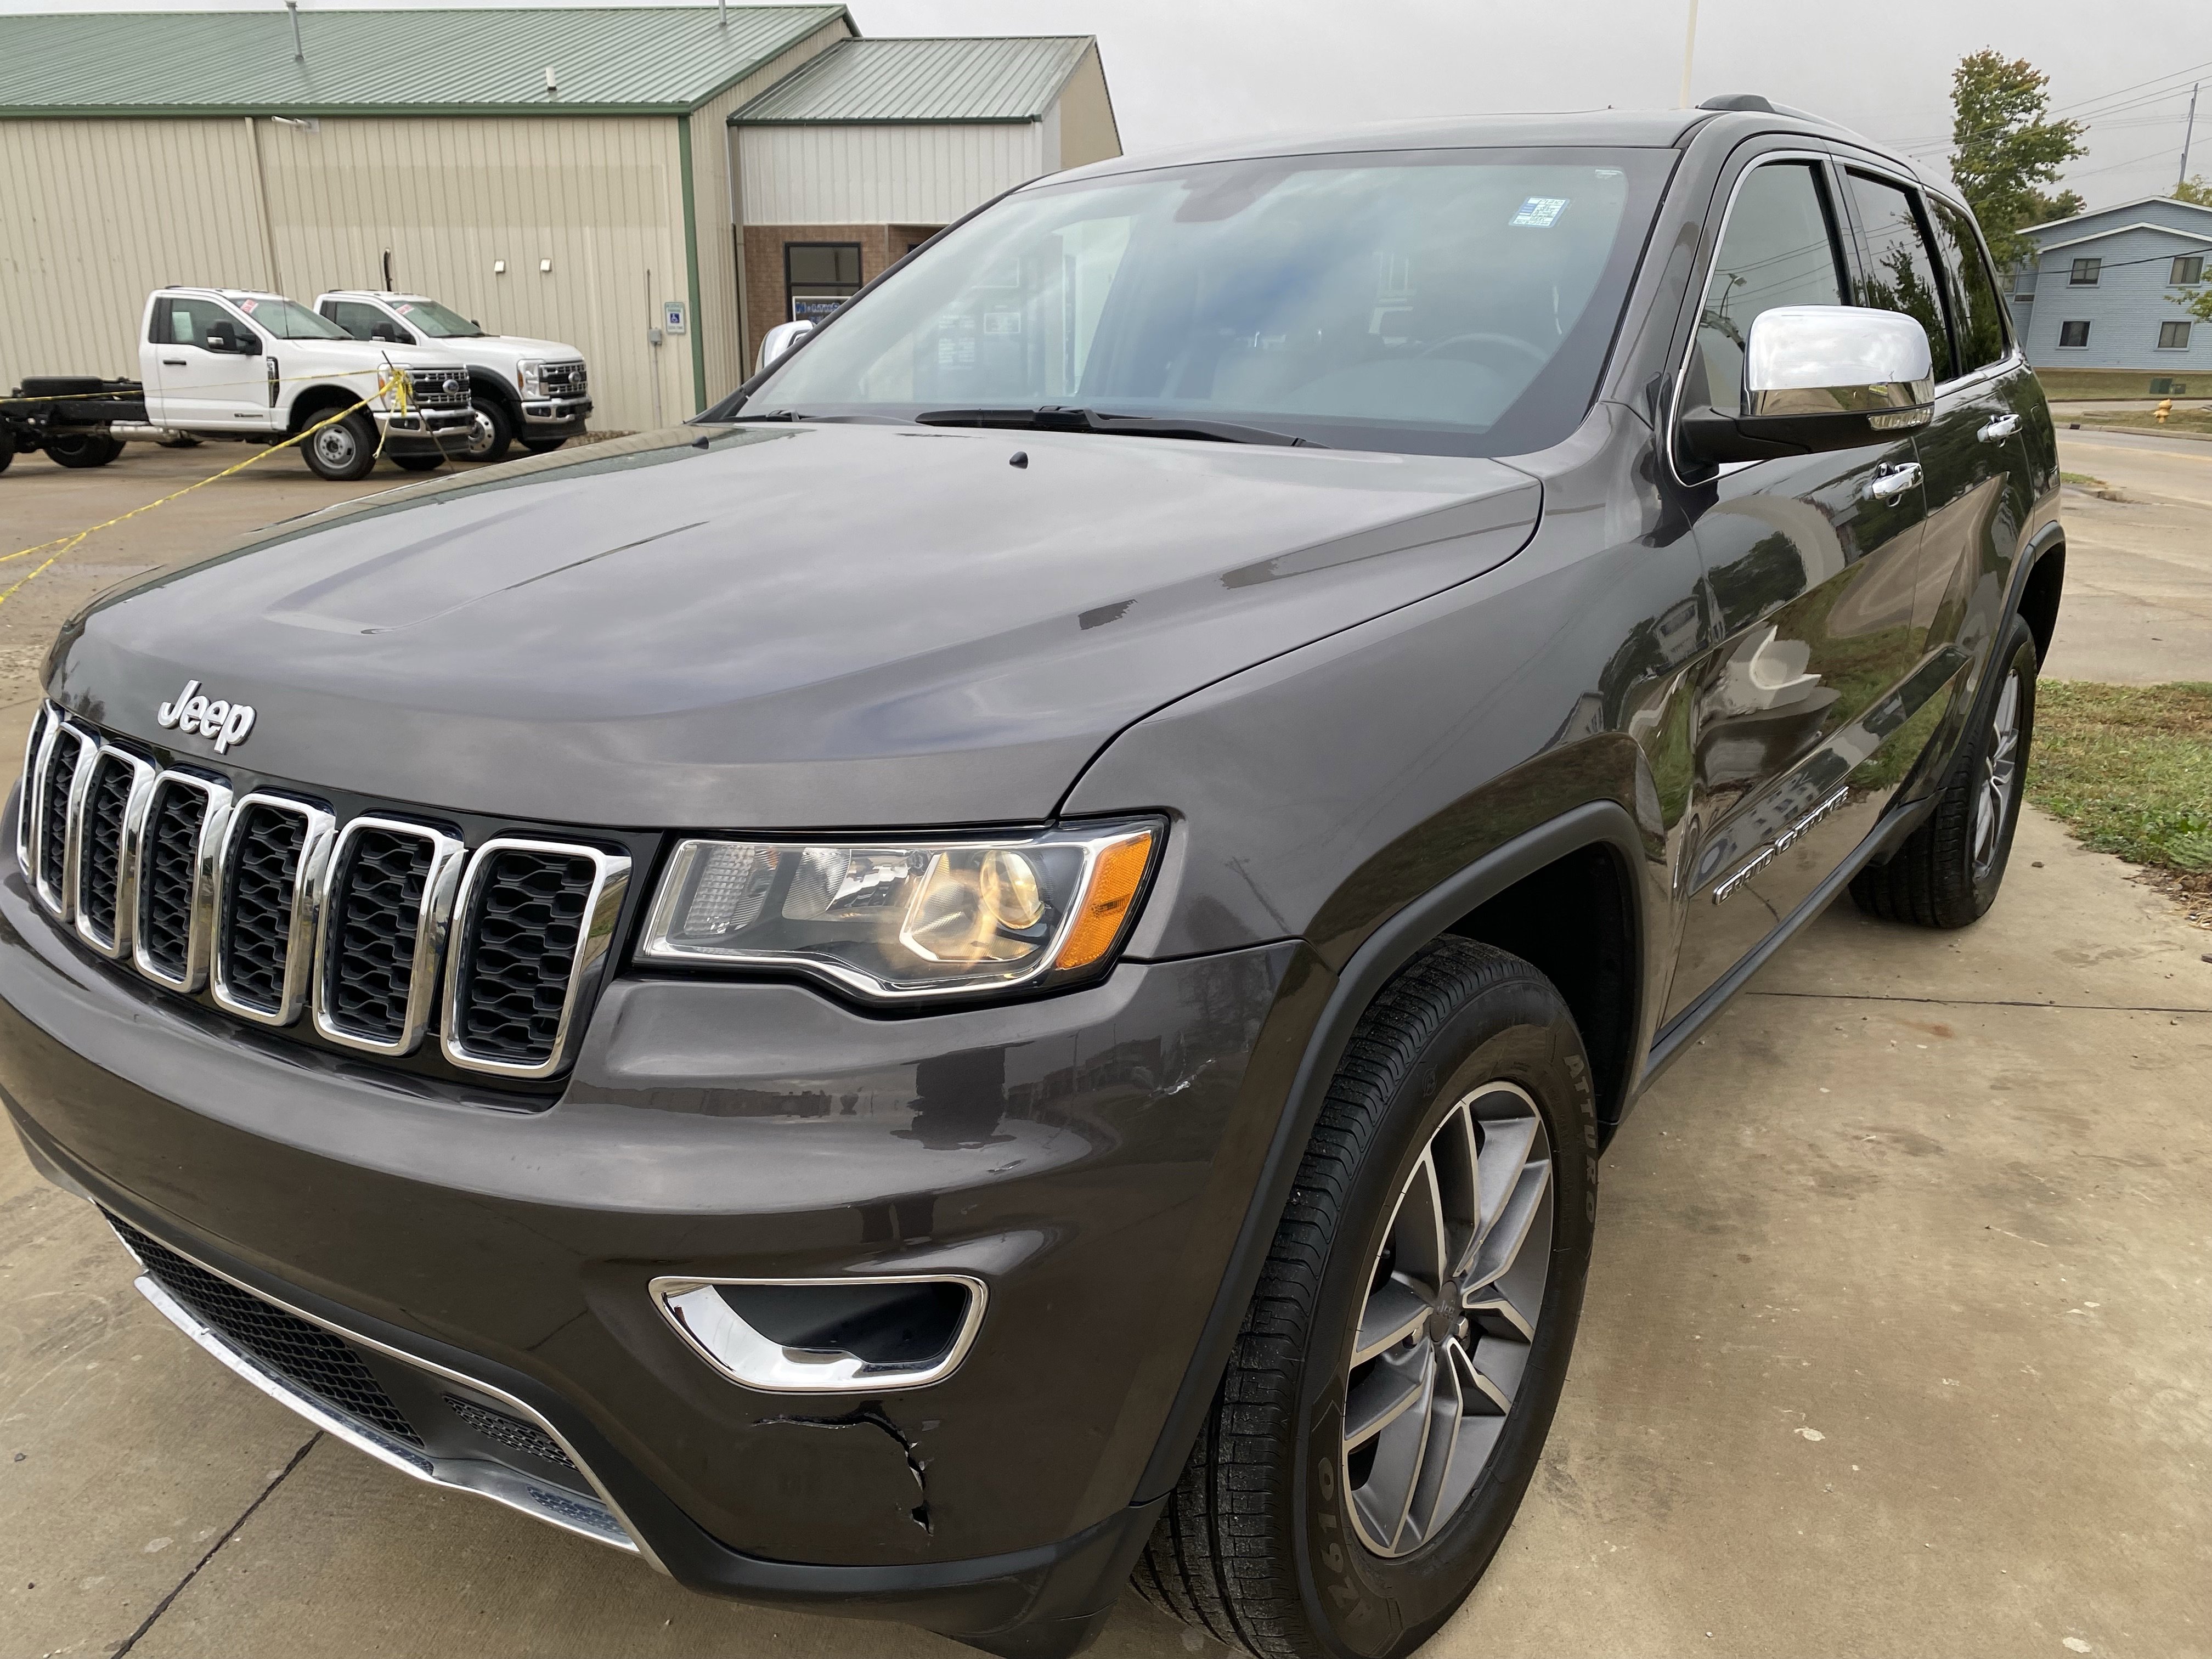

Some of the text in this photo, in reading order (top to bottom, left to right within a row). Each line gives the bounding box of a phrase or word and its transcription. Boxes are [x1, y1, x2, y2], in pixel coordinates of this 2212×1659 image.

[157, 680, 256, 755] Jeep
[1712, 848, 1775, 905] GRAND
[1563, 1054, 1597, 1223] ATTURO
